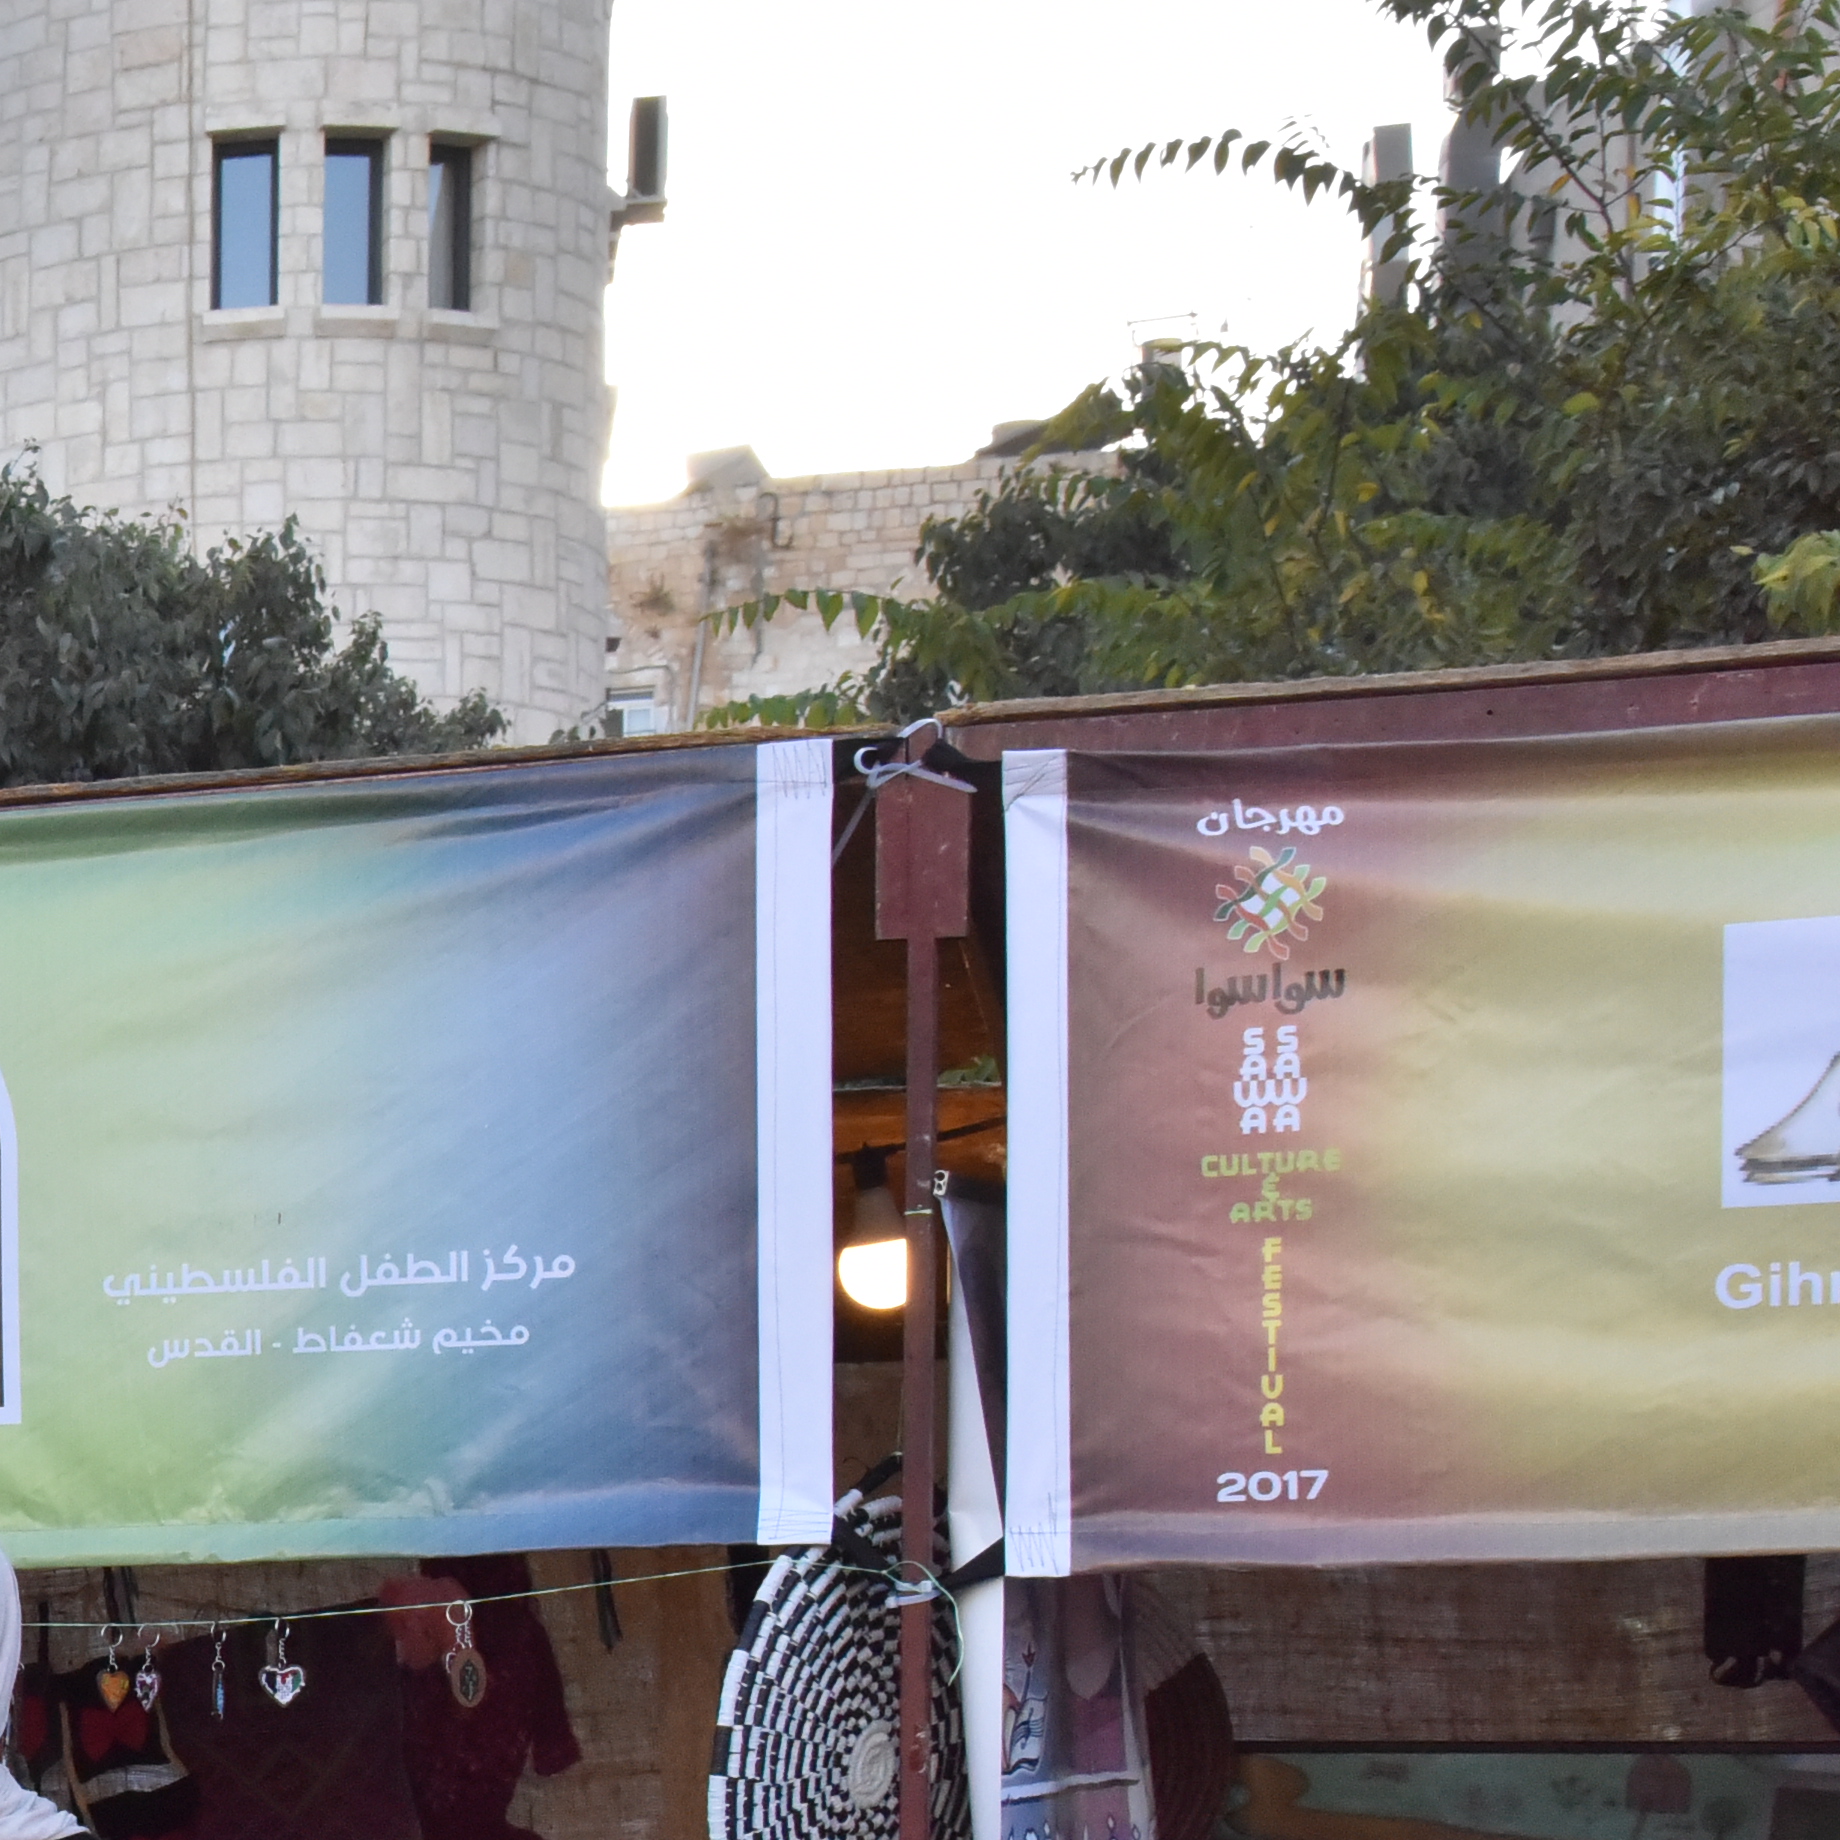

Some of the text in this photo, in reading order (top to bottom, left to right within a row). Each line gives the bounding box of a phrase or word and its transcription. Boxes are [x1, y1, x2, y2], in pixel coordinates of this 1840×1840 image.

[1196, 798, 1345, 836] مهرجان
[1201, 1149, 1341, 1178] CULTURE
[1229, 1198, 1313, 1224] ARTS
[102, 1245, 576, 1305] مركز الطفل الفلسطيني
[147, 1328, 262, 1368] القدس
[292, 1316, 421, 1354] شعفاط
[432, 1319, 531, 1355] مخيم
[1216, 1469, 1329, 1503] 2017
